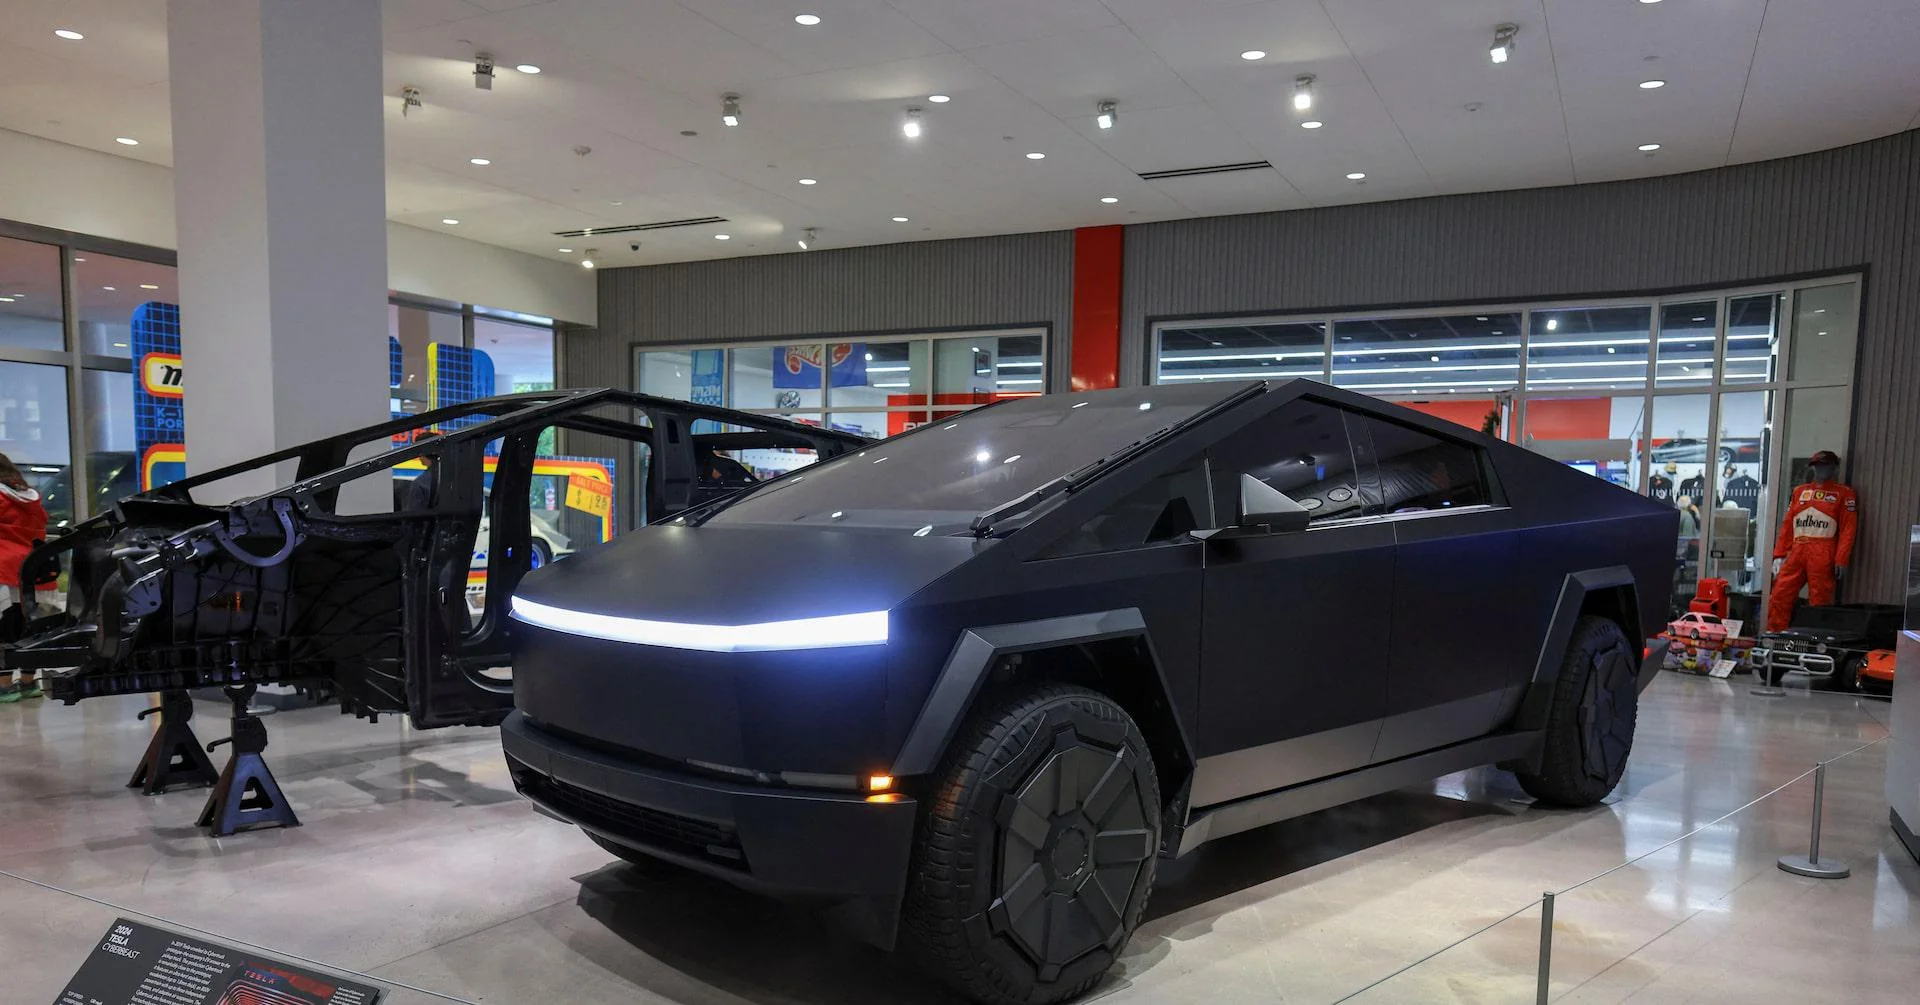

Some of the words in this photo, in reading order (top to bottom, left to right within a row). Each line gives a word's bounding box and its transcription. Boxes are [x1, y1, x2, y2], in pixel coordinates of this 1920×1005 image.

[115, 925, 133, 936] 2024
[109, 934, 129, 946] TESLA
[102, 943, 140, 959] CYBERBEAST
